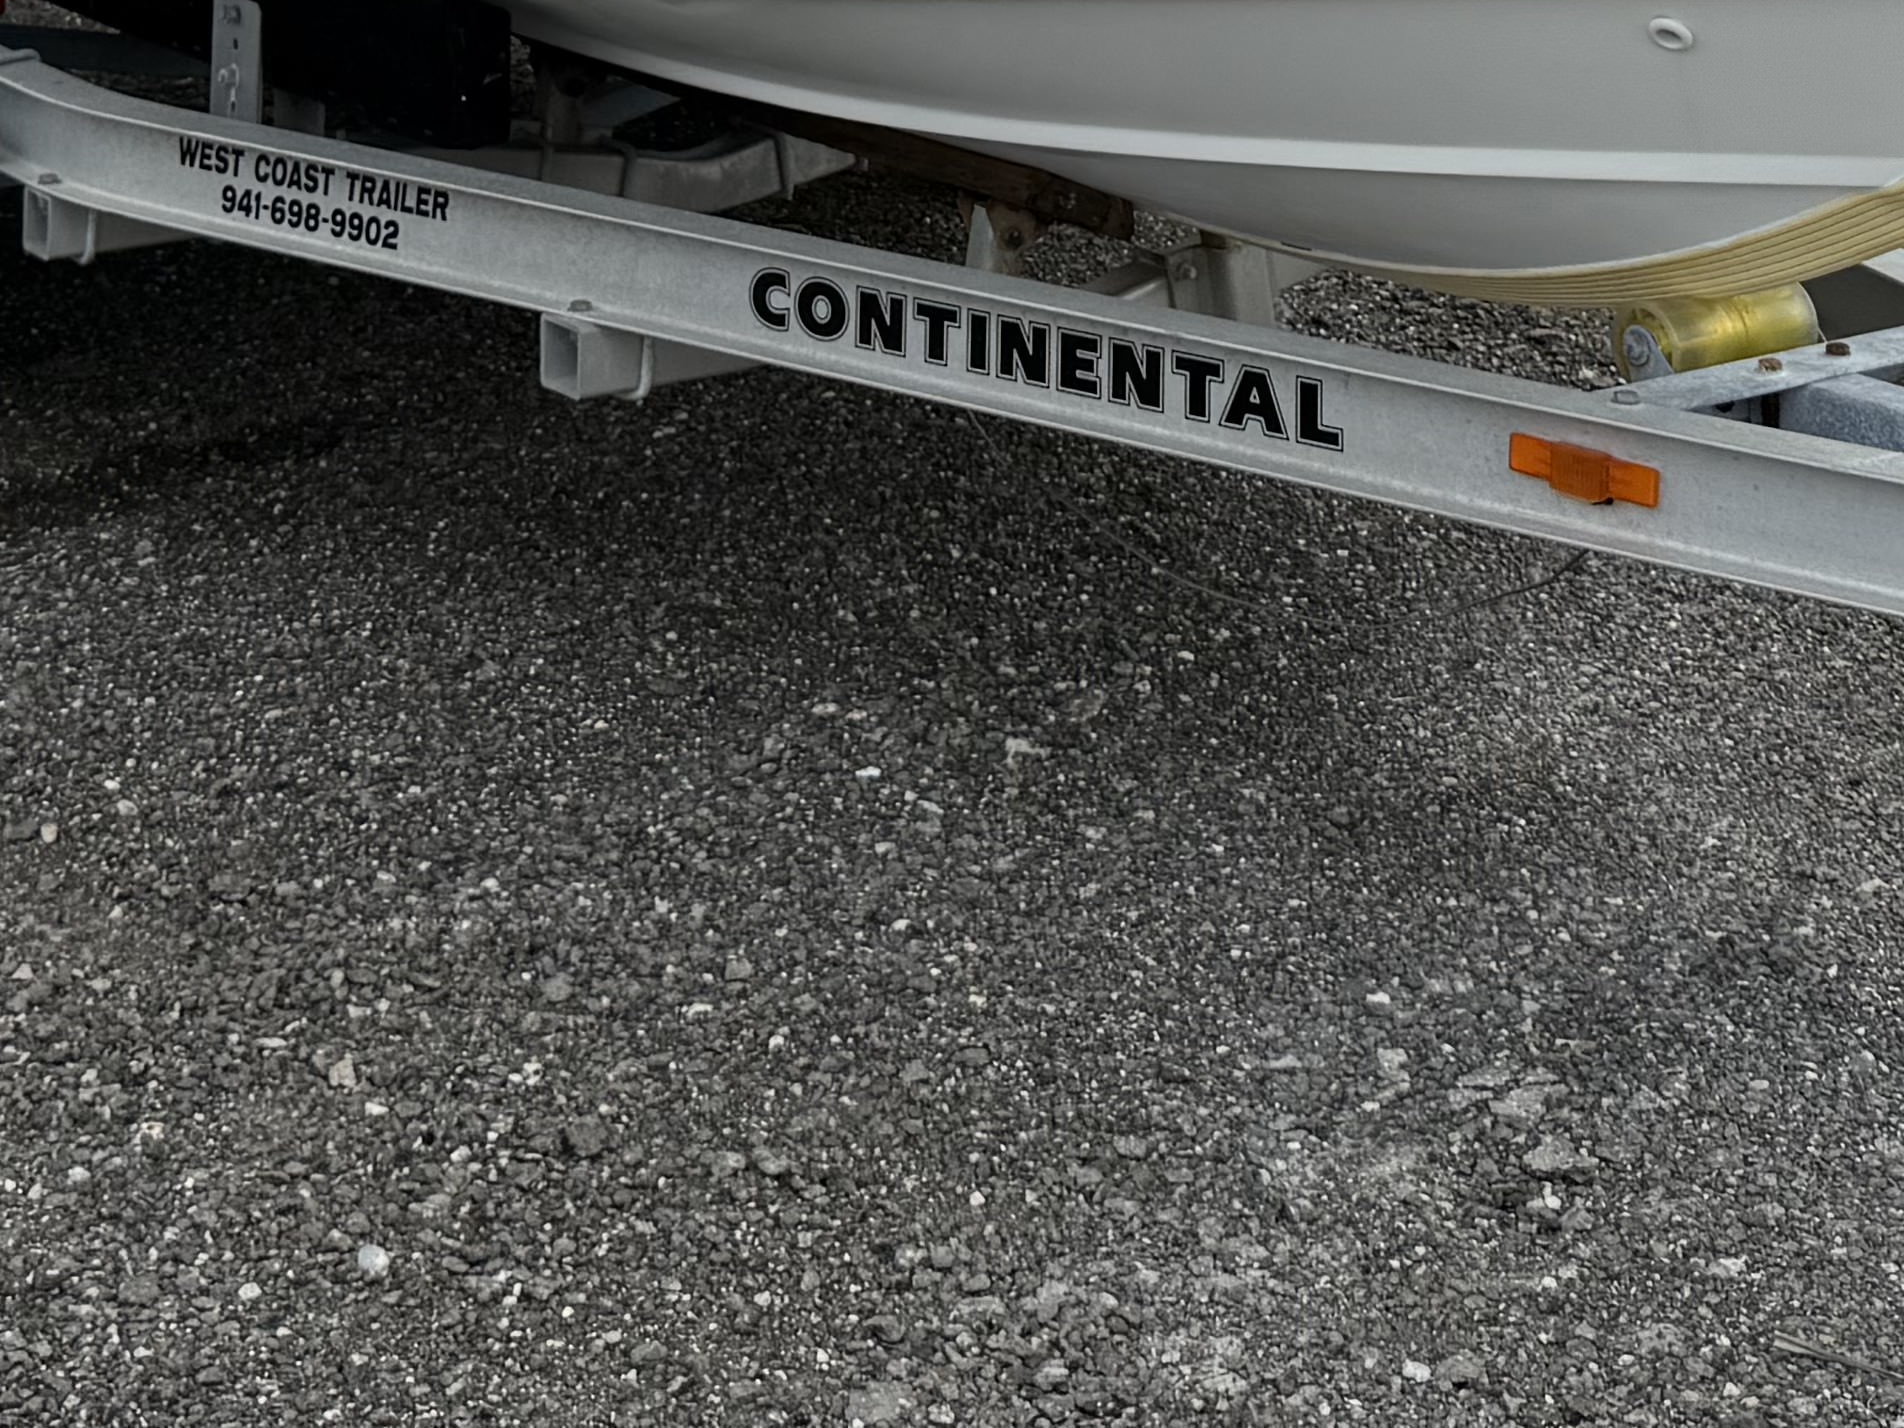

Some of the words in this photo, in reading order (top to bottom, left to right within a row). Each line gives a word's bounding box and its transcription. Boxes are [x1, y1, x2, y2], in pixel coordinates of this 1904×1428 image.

[178, 136, 245, 178] WEST
[254, 152, 334, 197] COAST
[346, 169, 450, 222] TRAILER
[220, 184, 400, 250] 941-698-9902
[749, 266, 1345, 452] CONTINENTAL
